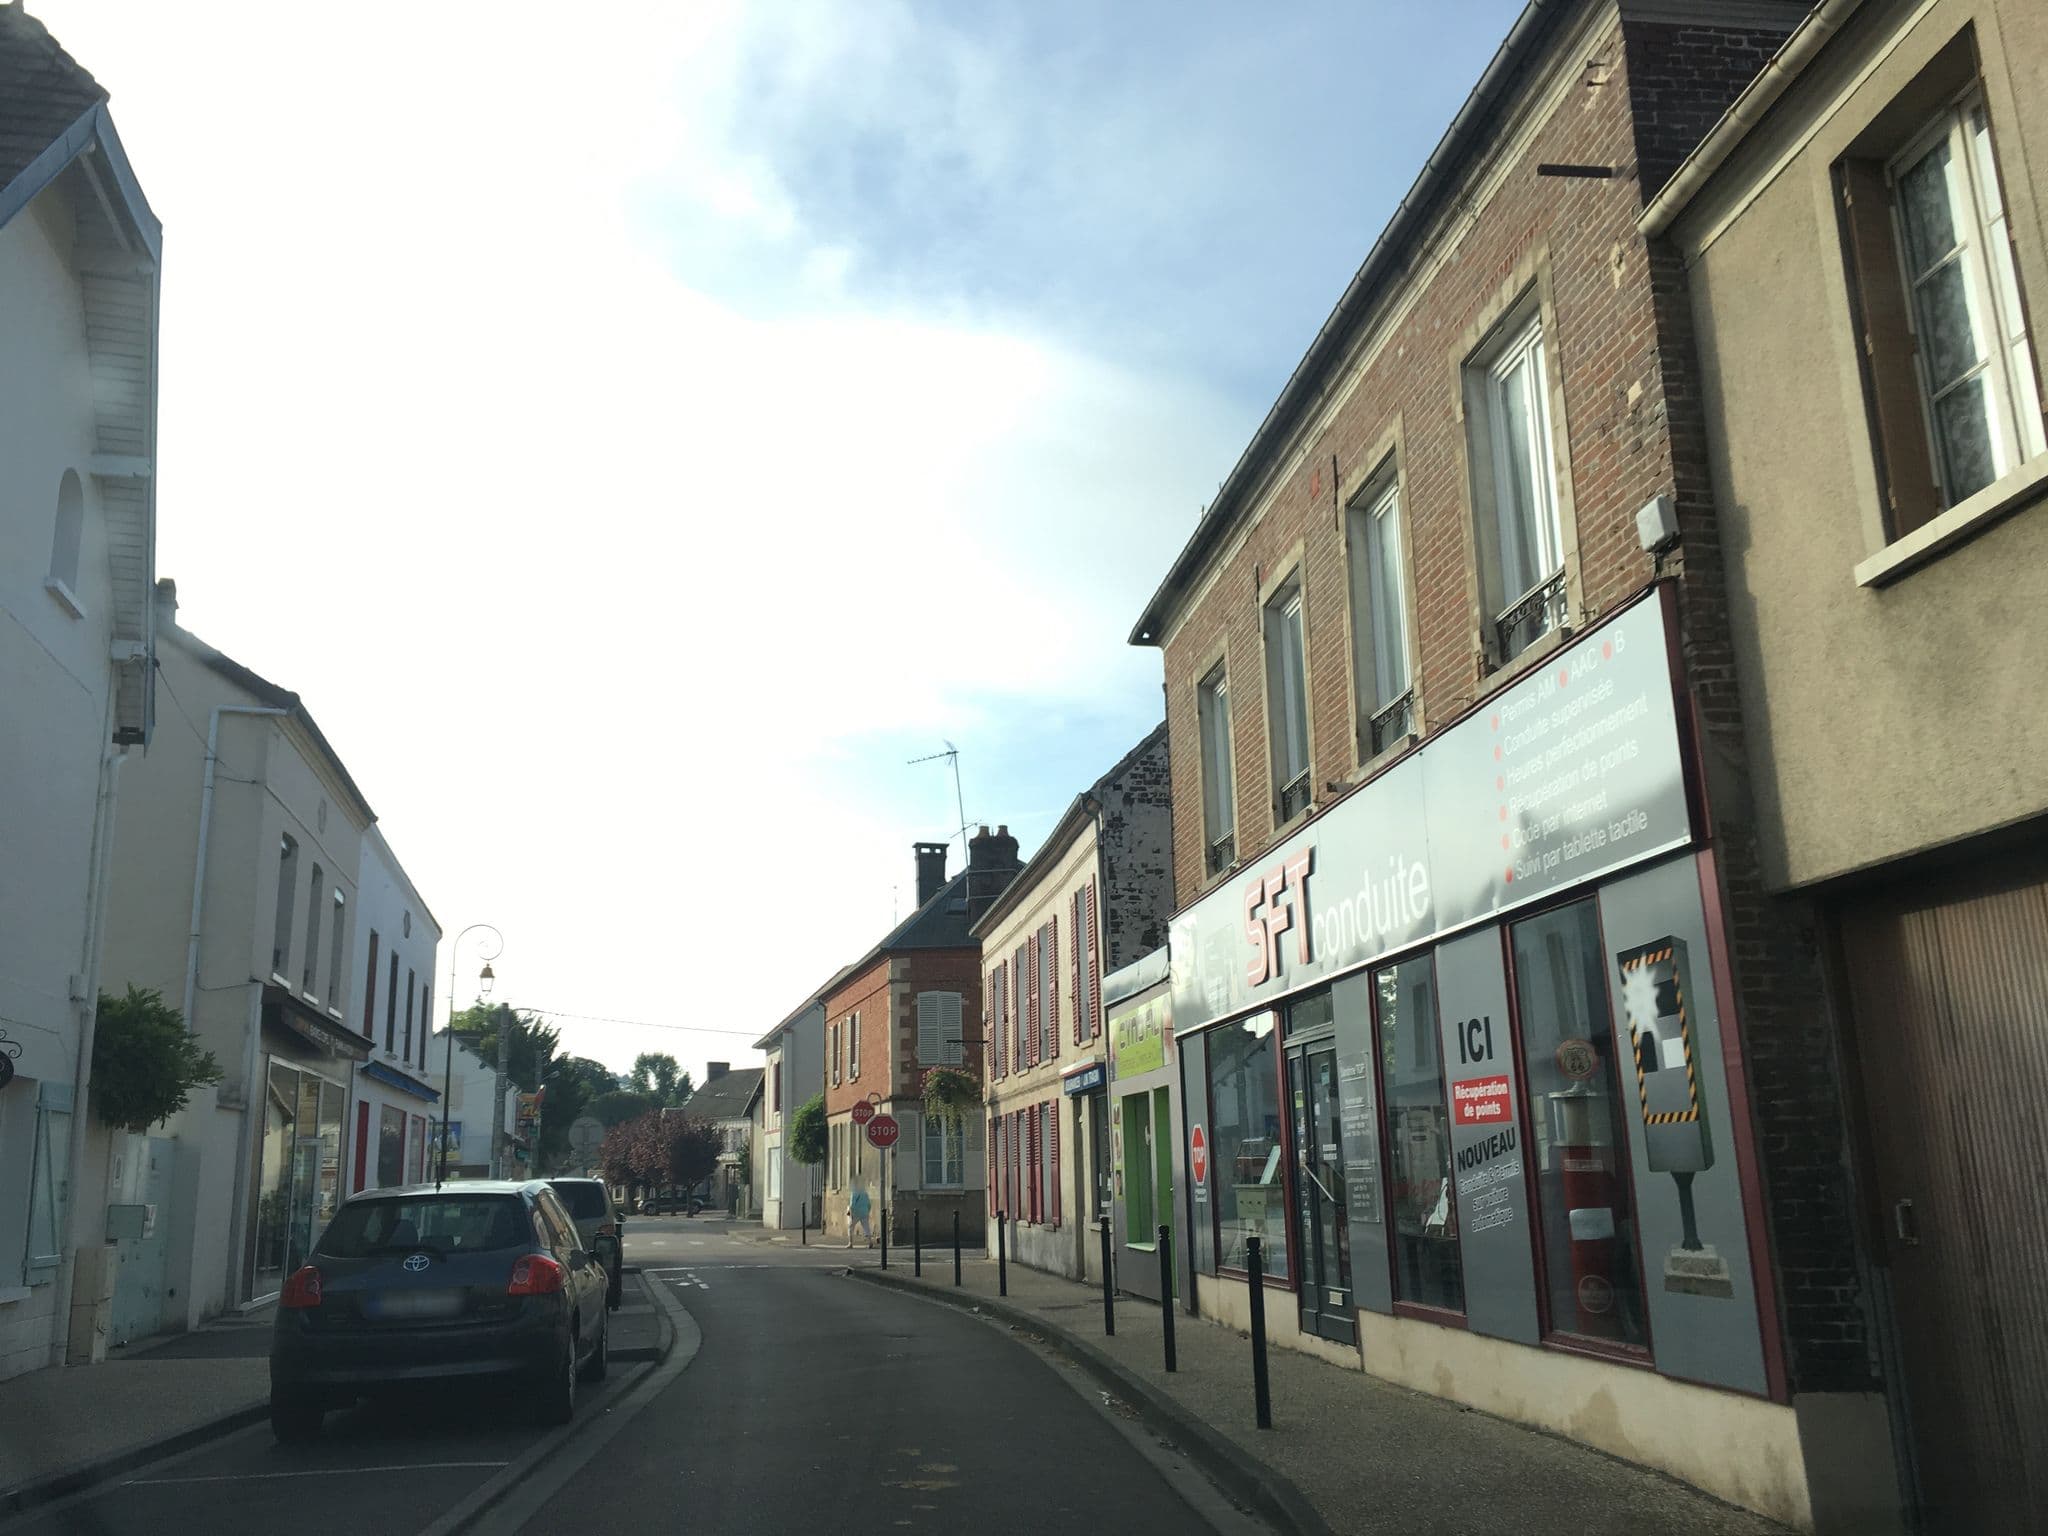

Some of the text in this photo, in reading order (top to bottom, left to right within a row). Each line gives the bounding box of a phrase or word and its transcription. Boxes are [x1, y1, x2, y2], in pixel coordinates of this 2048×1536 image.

[1500, 630, 1625, 725] Permis AM AAC B
[1503, 677, 1614, 756] Conduite supervisée
[1507, 693, 1648, 785] Heures perfectionnement
[1509, 738, 1640, 814] Récupération de points
[1513, 790, 1607, 848] Code par internet
[1516, 808, 1648, 880] Suivi par tablette tactile
[1245, 847, 1430, 987] SFT conduite
[1458, 1016, 1494, 1065] ICI
[854, 1108, 873, 1117] STOP
[1455, 1080, 1509, 1101] Récupération
[1464, 1101, 1502, 1120] de points
[871, 1127, 897, 1136] STOP
[1457, 1127, 1517, 1173] NOUVEAU
[1495, 1158, 1520, 1183] Permis
[1472, 1208, 1513, 1233] automatique
